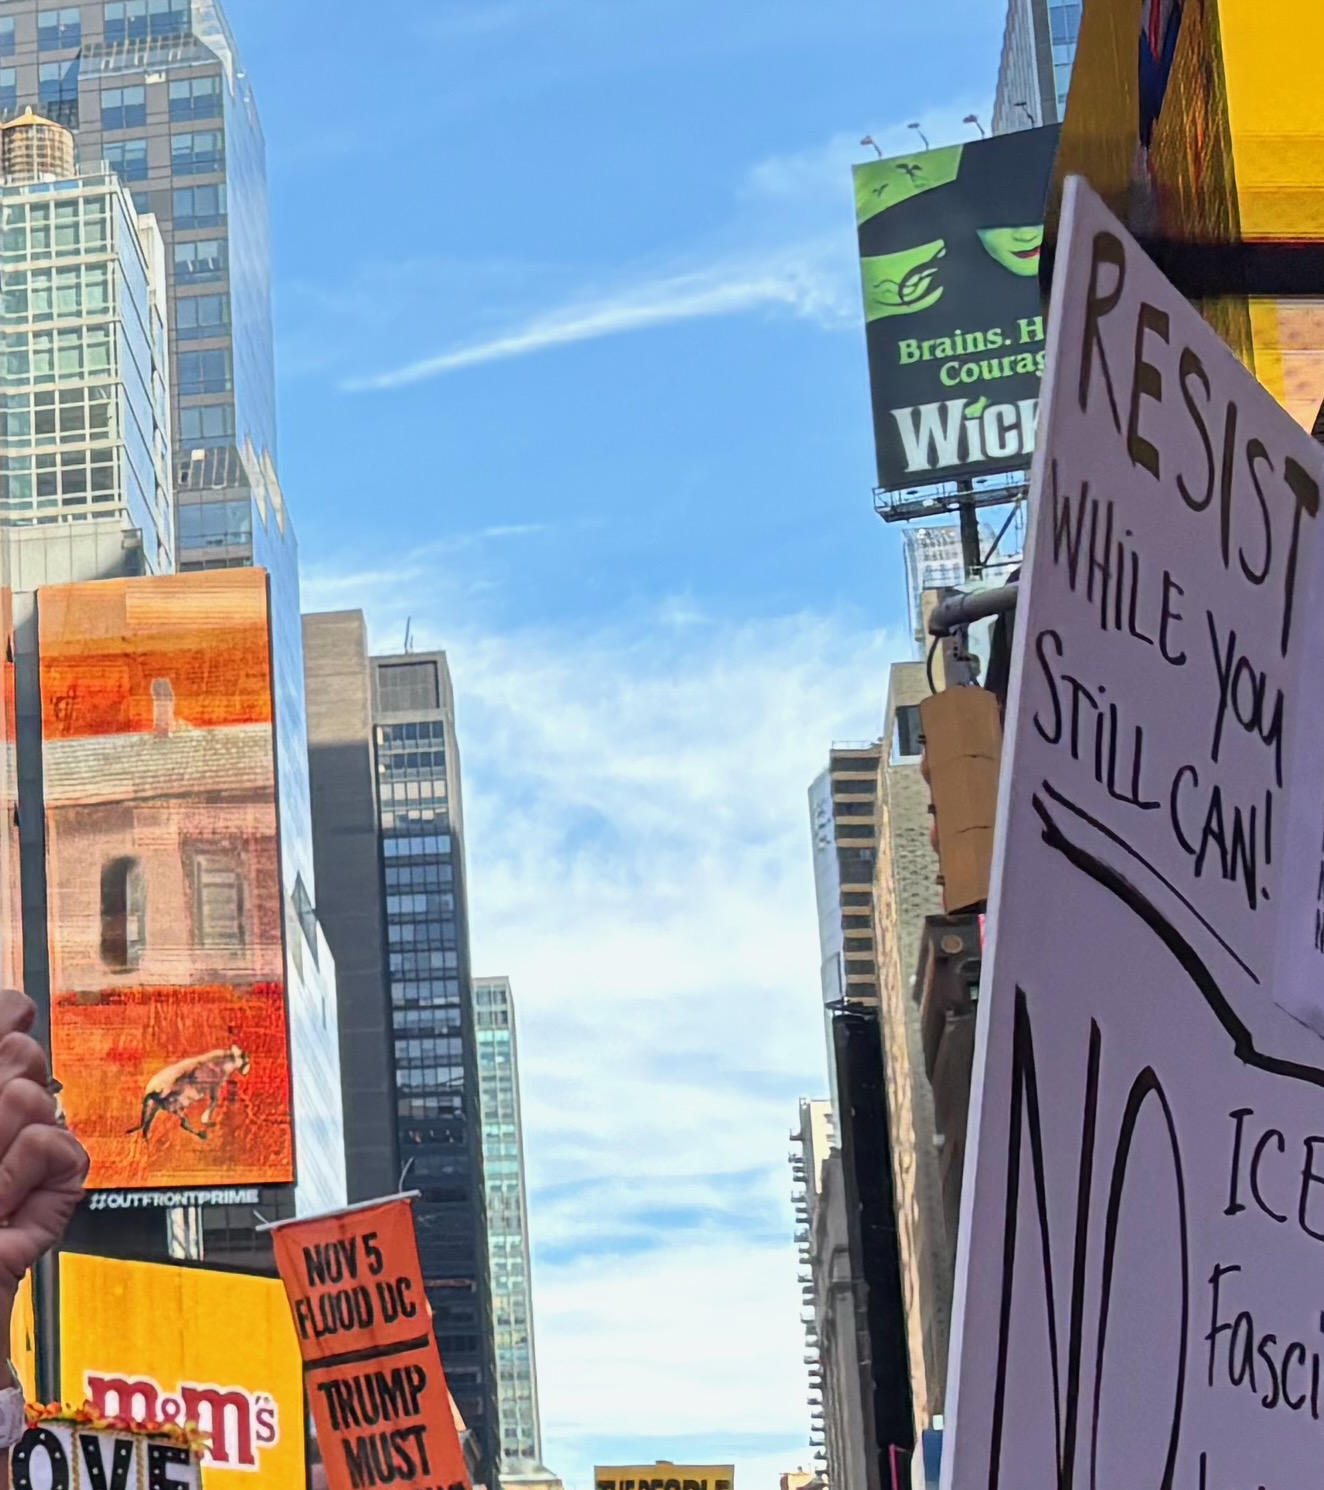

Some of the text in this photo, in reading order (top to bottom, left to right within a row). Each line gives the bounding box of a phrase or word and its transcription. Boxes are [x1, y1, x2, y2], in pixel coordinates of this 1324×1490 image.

[898, 329, 1012, 365] Brains.
[1079, 231, 1320, 658] RESIST
[1171, 765, 1273, 911] CAN!
[89, 1187, 259, 1210] #OUTFRONTPRIME
[1223, 1107, 1324, 1243] ICE
[303, 1232, 384, 1288] NOV 5
[295, 1277, 418, 1342] FLOOD DC
[317, 1364, 427, 1434] TRUMP
[342, 1424, 431, 1490] MUST
